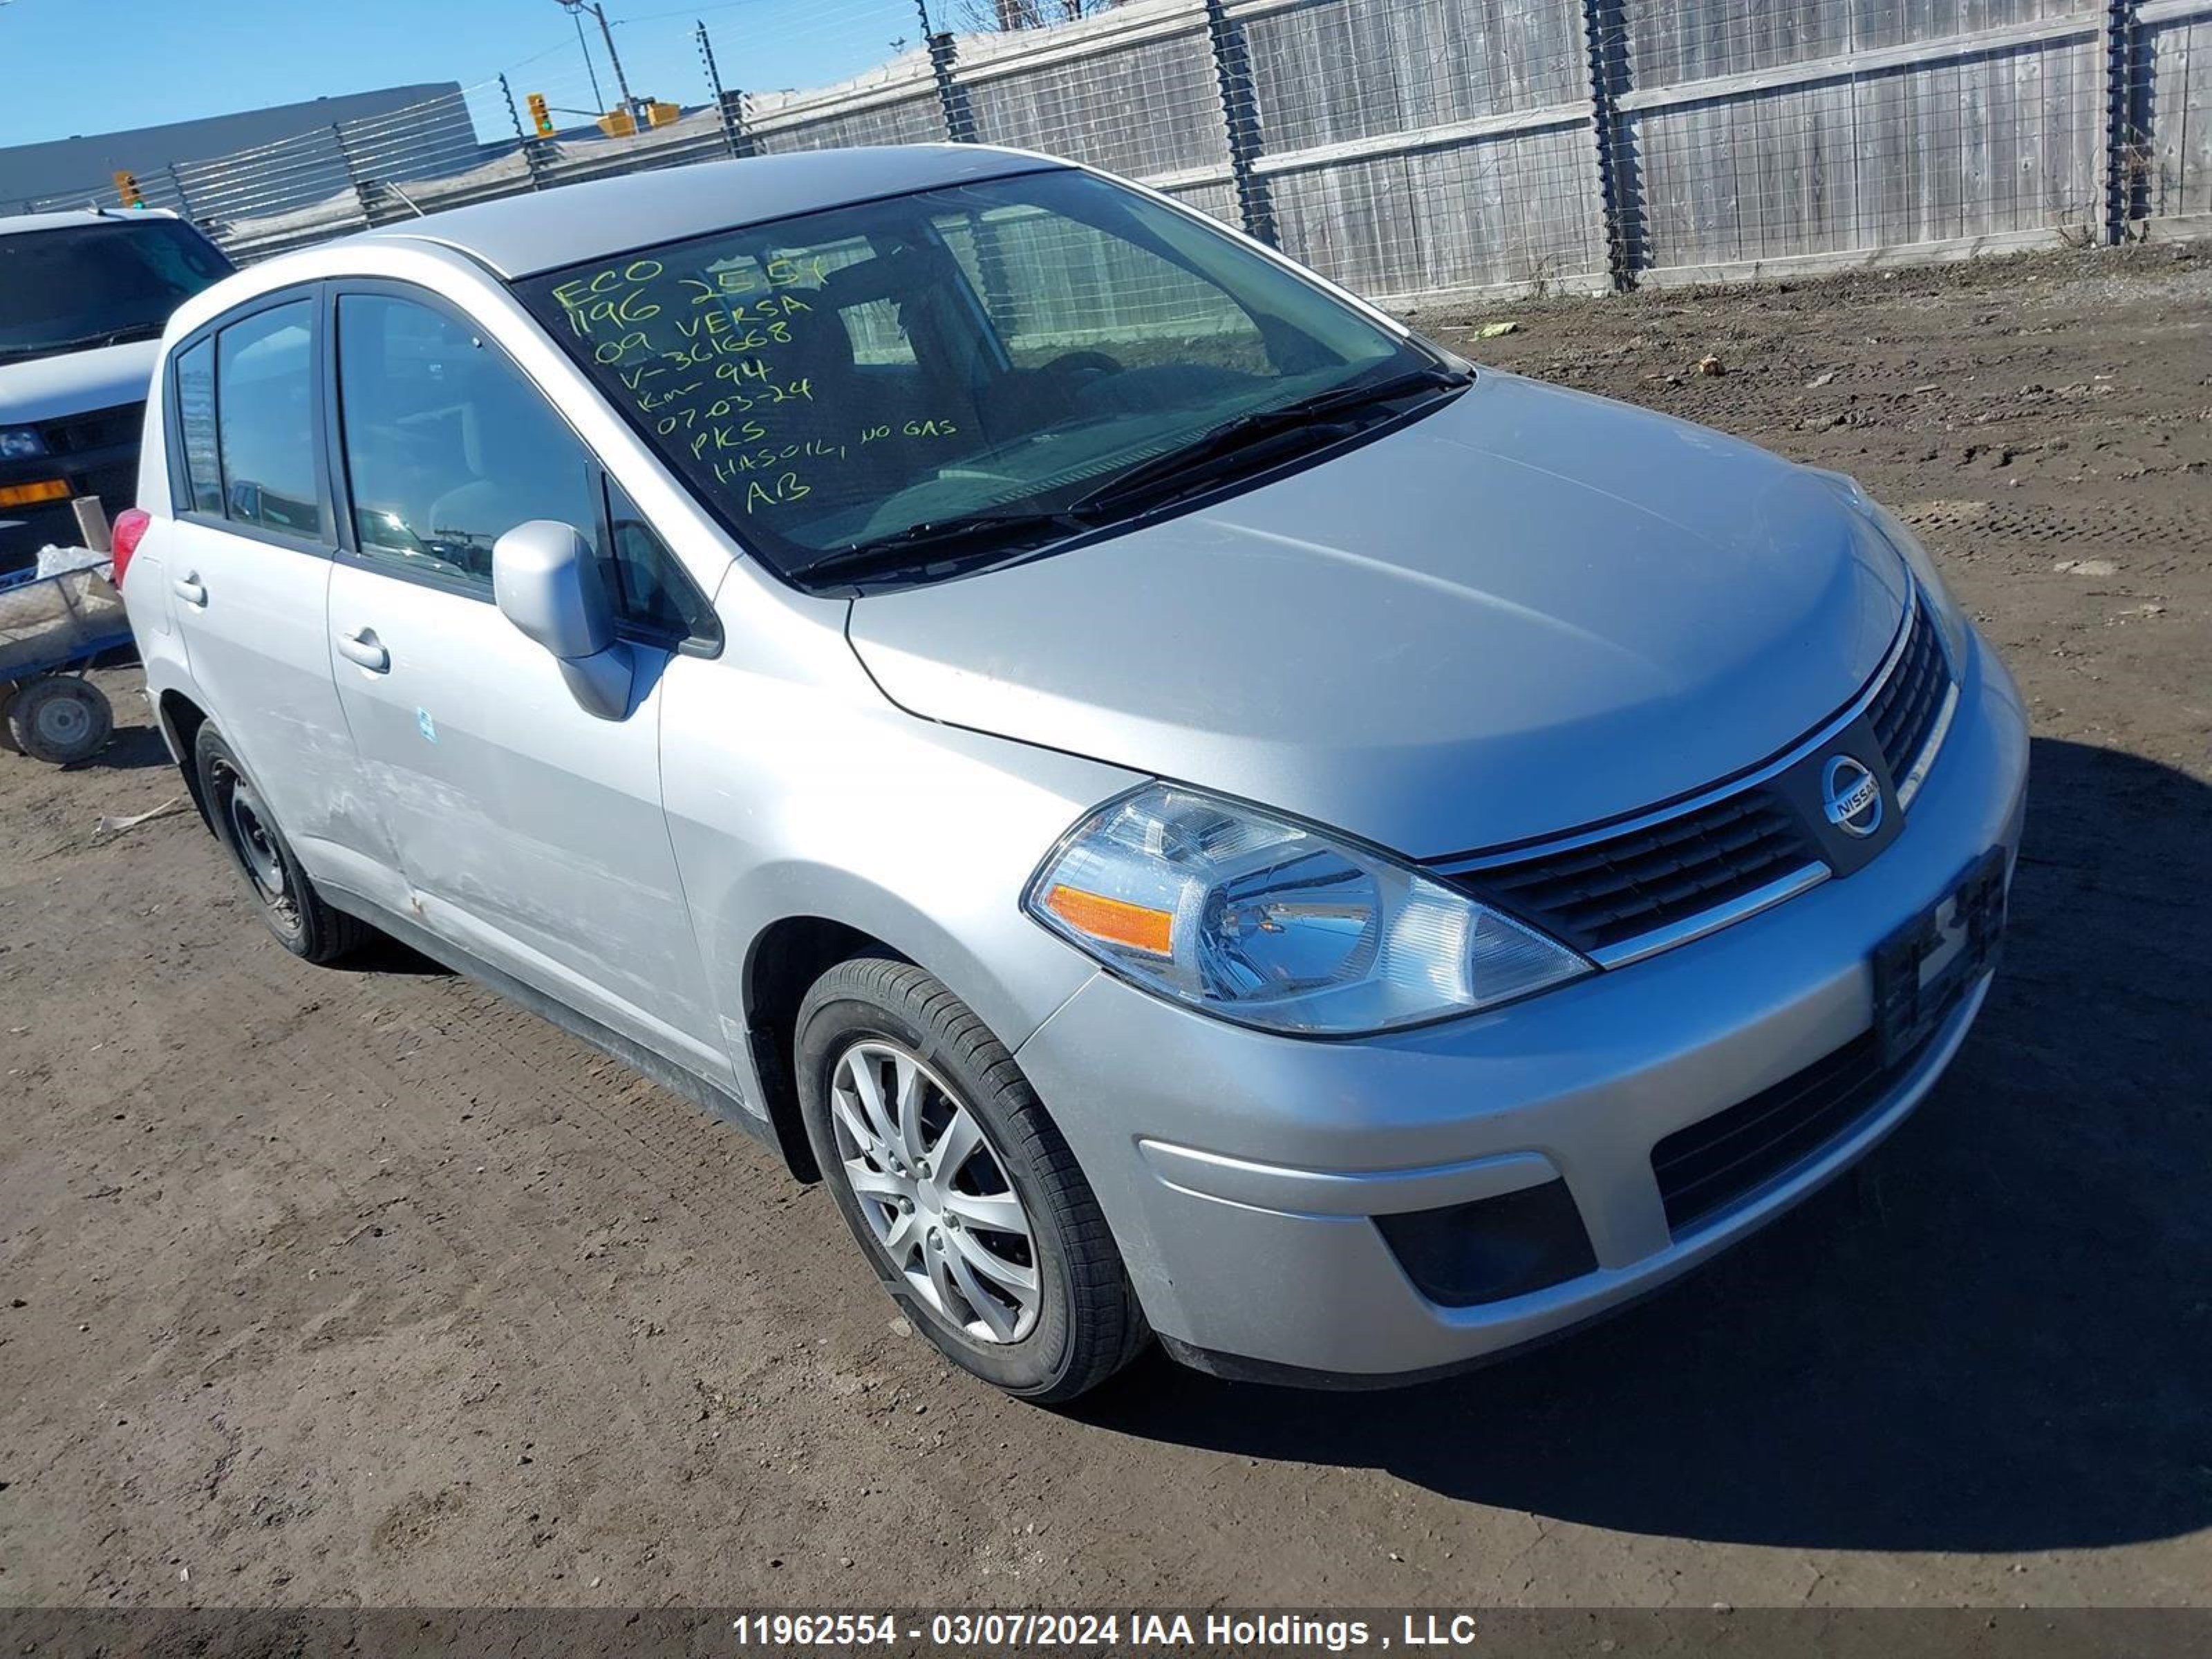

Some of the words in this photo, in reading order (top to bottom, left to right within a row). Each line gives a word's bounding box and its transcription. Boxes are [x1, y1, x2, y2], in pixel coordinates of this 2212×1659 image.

[552, 260, 663, 311] ECO
[565, 288, 661, 339] 1196
[675, 295, 814, 338] VERSA
[715, 359, 774, 386] 94
[691, 420, 765, 460] PKS
[860, 425, 891, 444] NO
[903, 420, 957, 437] GAS
[747, 471, 812, 515] AB
[1837, 779, 1879, 818] NISSAN
